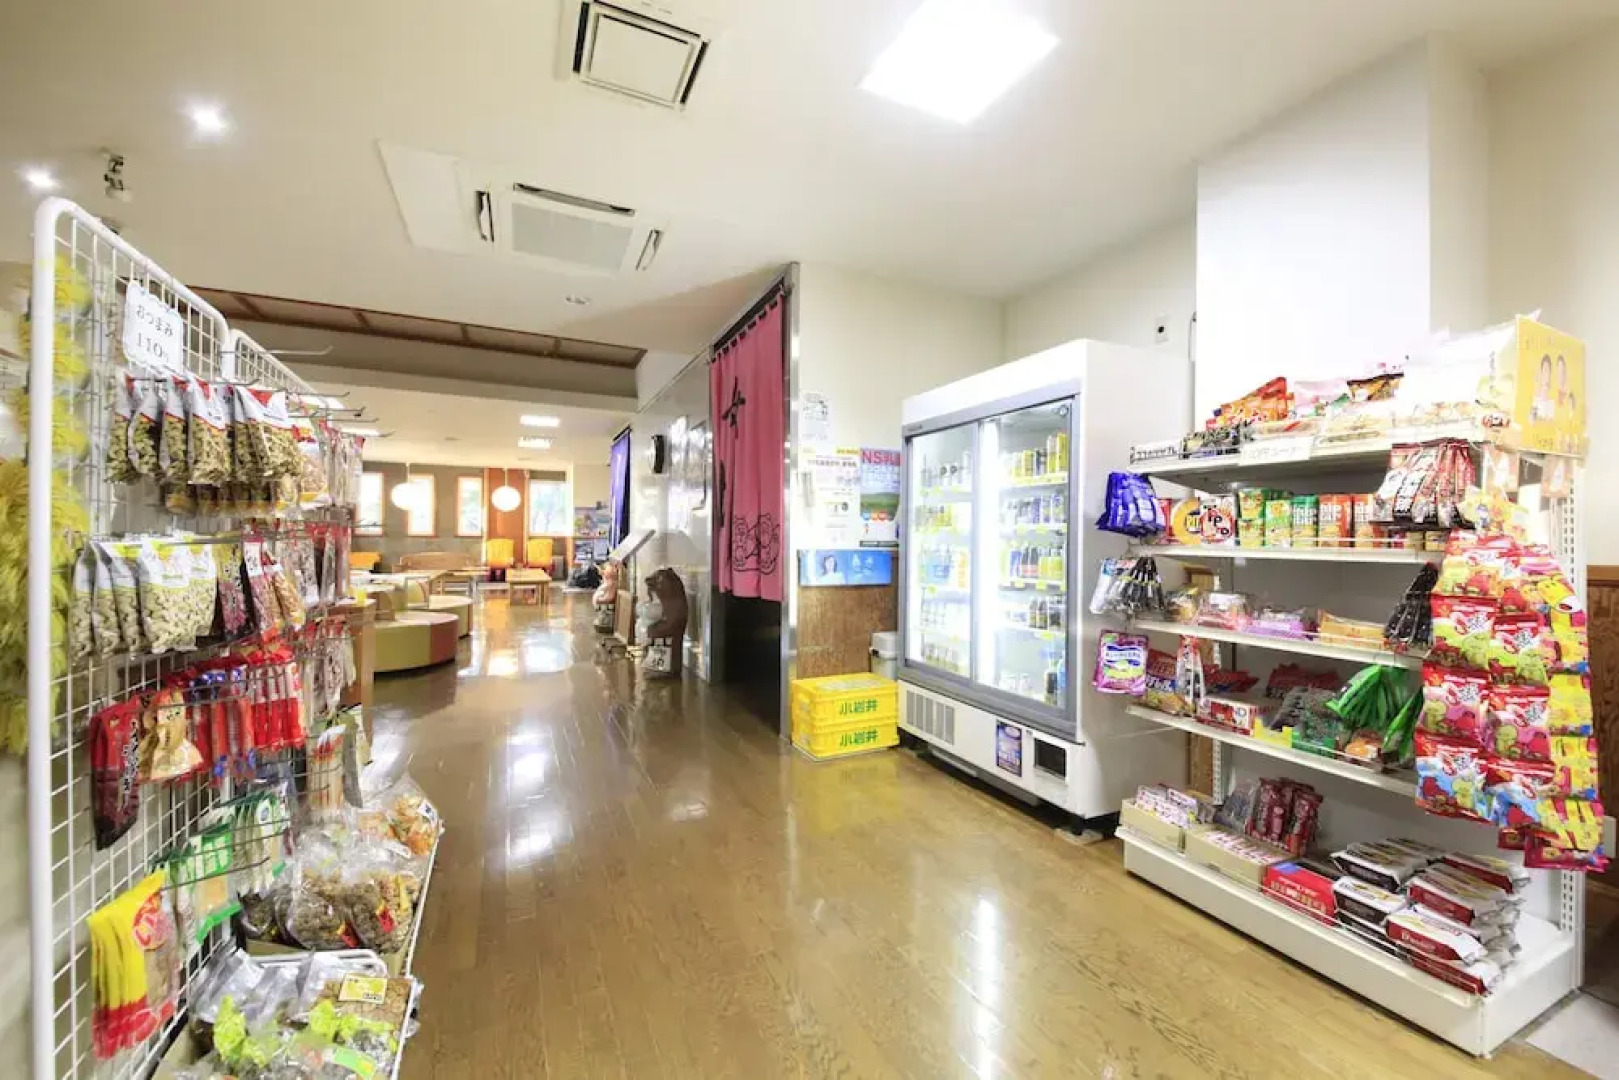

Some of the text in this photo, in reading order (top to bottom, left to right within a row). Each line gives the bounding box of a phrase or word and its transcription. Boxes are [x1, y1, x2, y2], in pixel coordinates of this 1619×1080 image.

[136, 304, 173, 337] おつまみ
[840, 699, 877, 716] 小岩井
[840, 731, 877, 747] 小岩井
